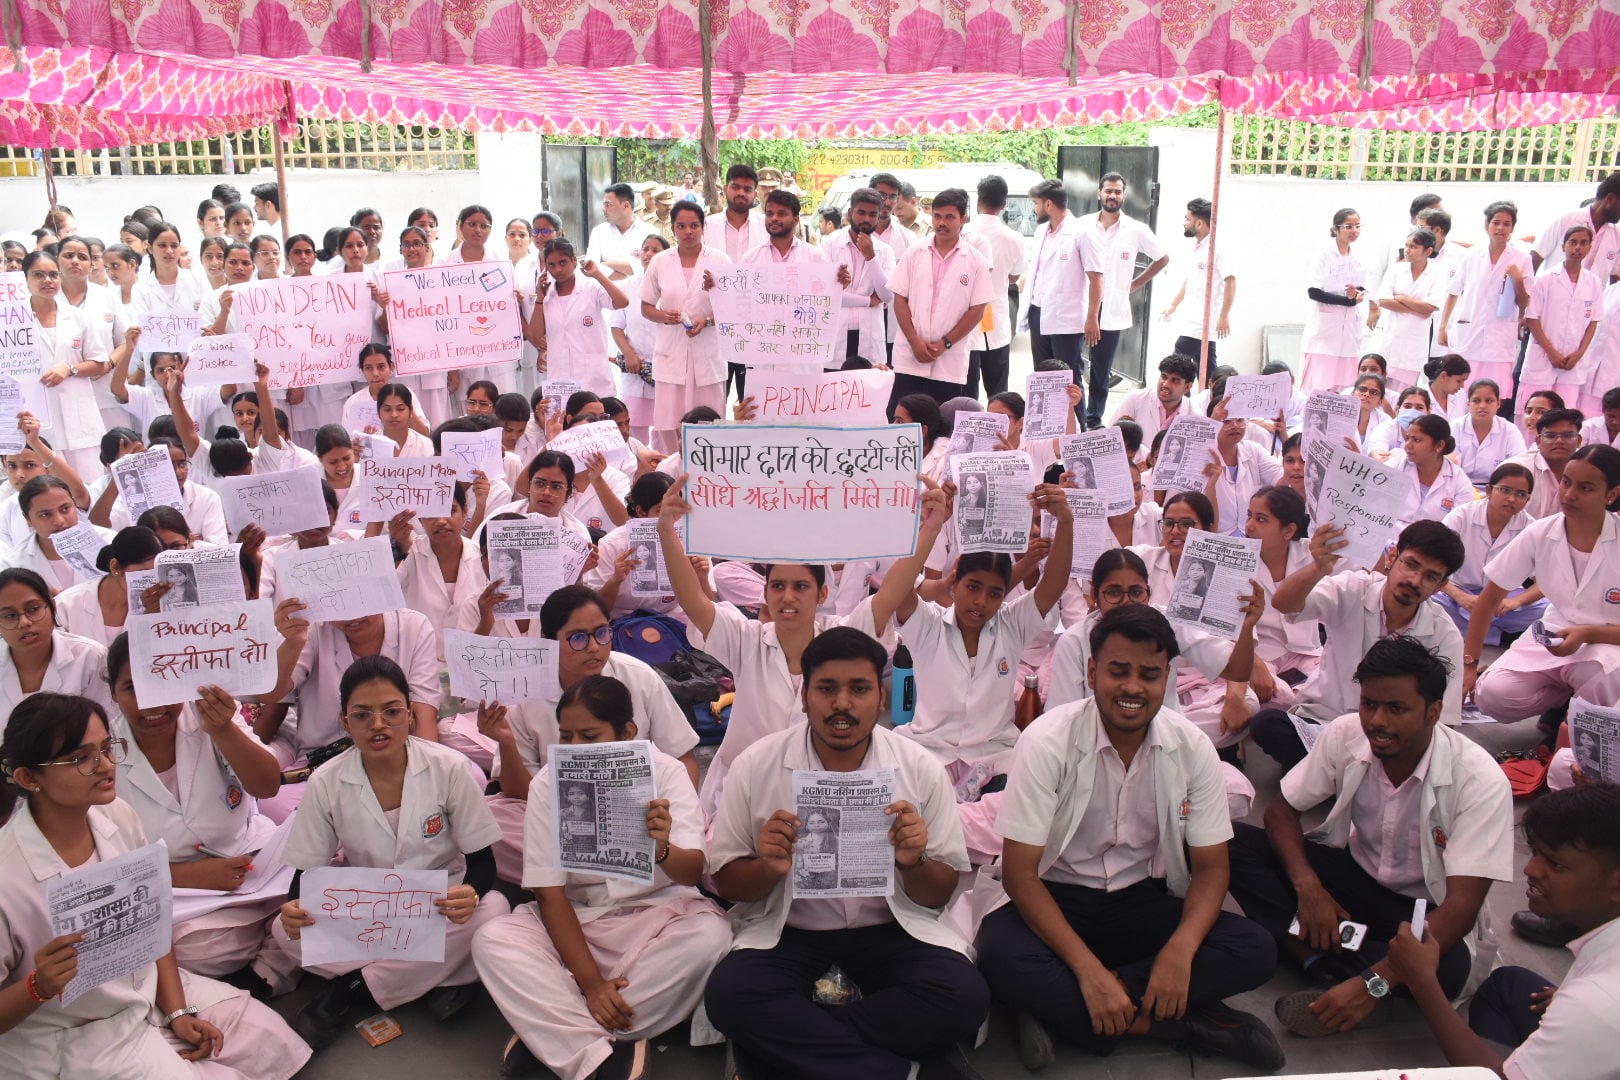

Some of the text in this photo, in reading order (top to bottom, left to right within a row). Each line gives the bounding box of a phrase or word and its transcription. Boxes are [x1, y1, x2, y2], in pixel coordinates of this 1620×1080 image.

[441, 269, 476, 288] Need
[237, 280, 357, 317] NOW DEAN
[392, 294, 508, 320] Medical Leave
[435, 317, 461, 333] NOT
[744, 322, 766, 338] कर
[396, 344, 442, 364] Medical
[763, 379, 872, 417] PRINCIPAL
[690, 436, 752, 475] बीमार
[801, 437, 833, 474] को
[1339, 456, 1388, 486] WHO
[691, 475, 740, 509] सीधे
[1351, 483, 1367, 498] is
[1326, 487, 1395, 529] Responsible
[150, 612, 249, 640] Principal
[150, 645, 235, 681] इस्तीफा
[561, 760, 590, 769] KGMU
[801, 786, 831, 796] KGMU
[80, 892, 134, 927] प्रशासन
[132, 884, 150, 902] की
[321, 873, 442, 921] इस्तीफा
